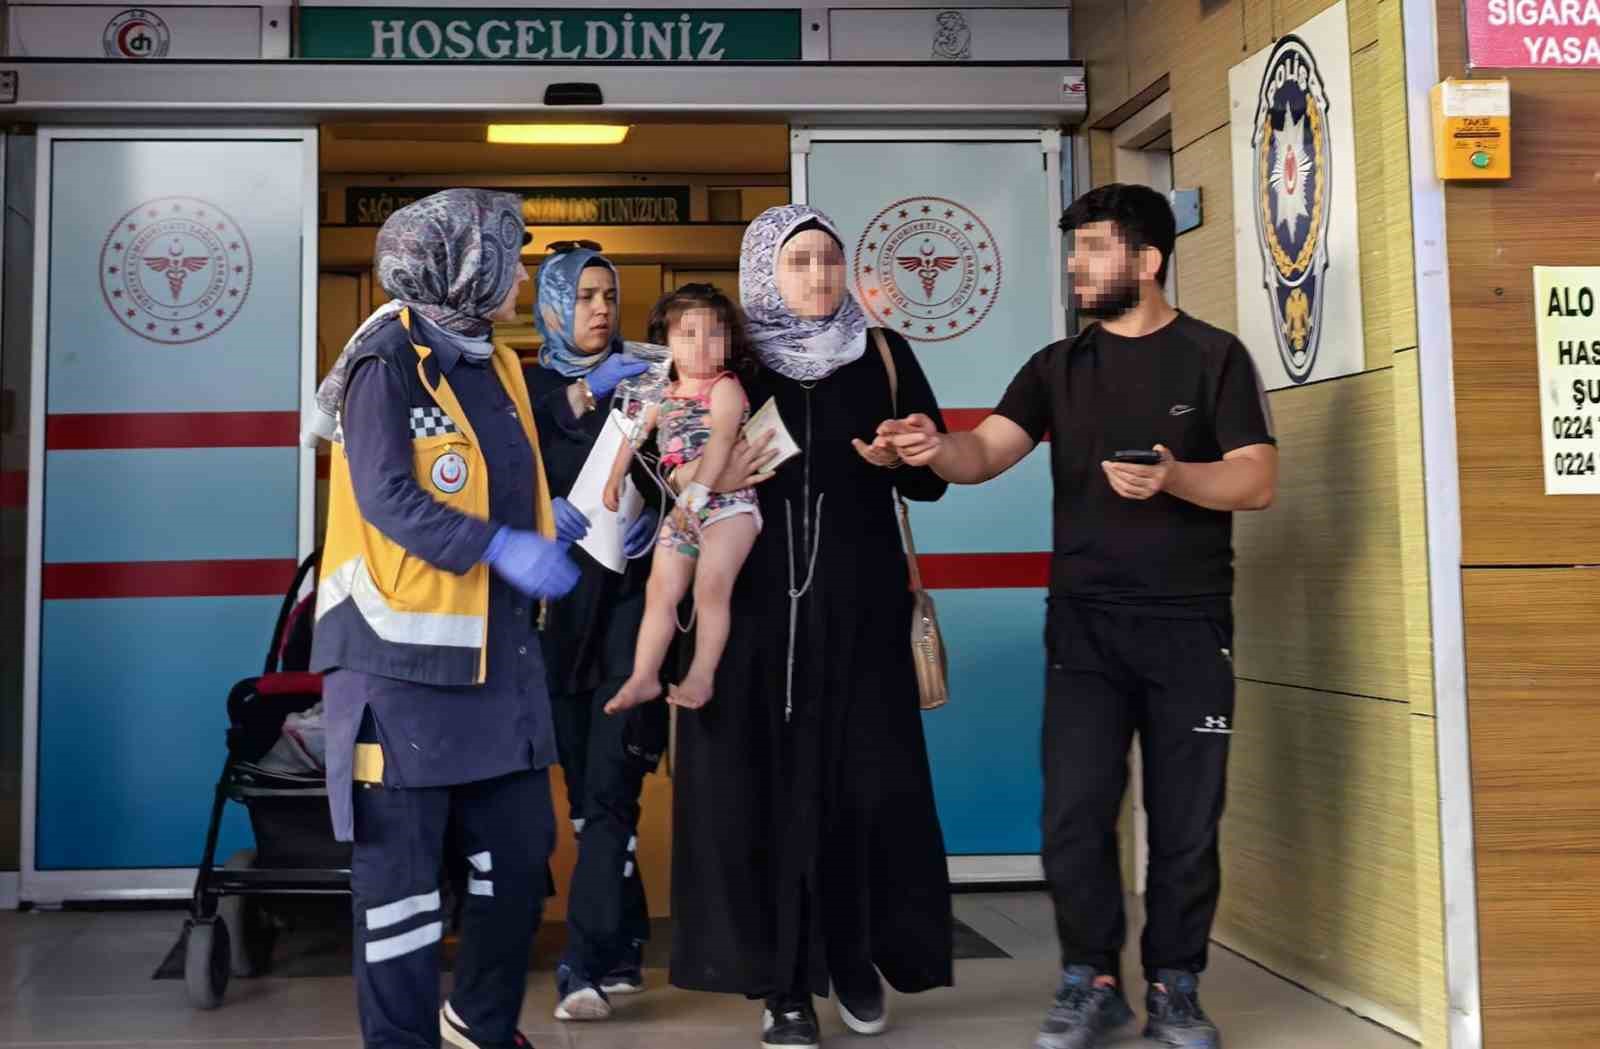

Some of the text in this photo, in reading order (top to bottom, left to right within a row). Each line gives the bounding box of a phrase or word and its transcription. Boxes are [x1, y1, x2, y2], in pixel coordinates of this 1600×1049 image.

[1523, 36, 1600, 64] YASA
[1548, 287, 1593, 317] ALO
[1553, 416, 1593, 439] 0224
[1555, 452, 1595, 476] 0224
